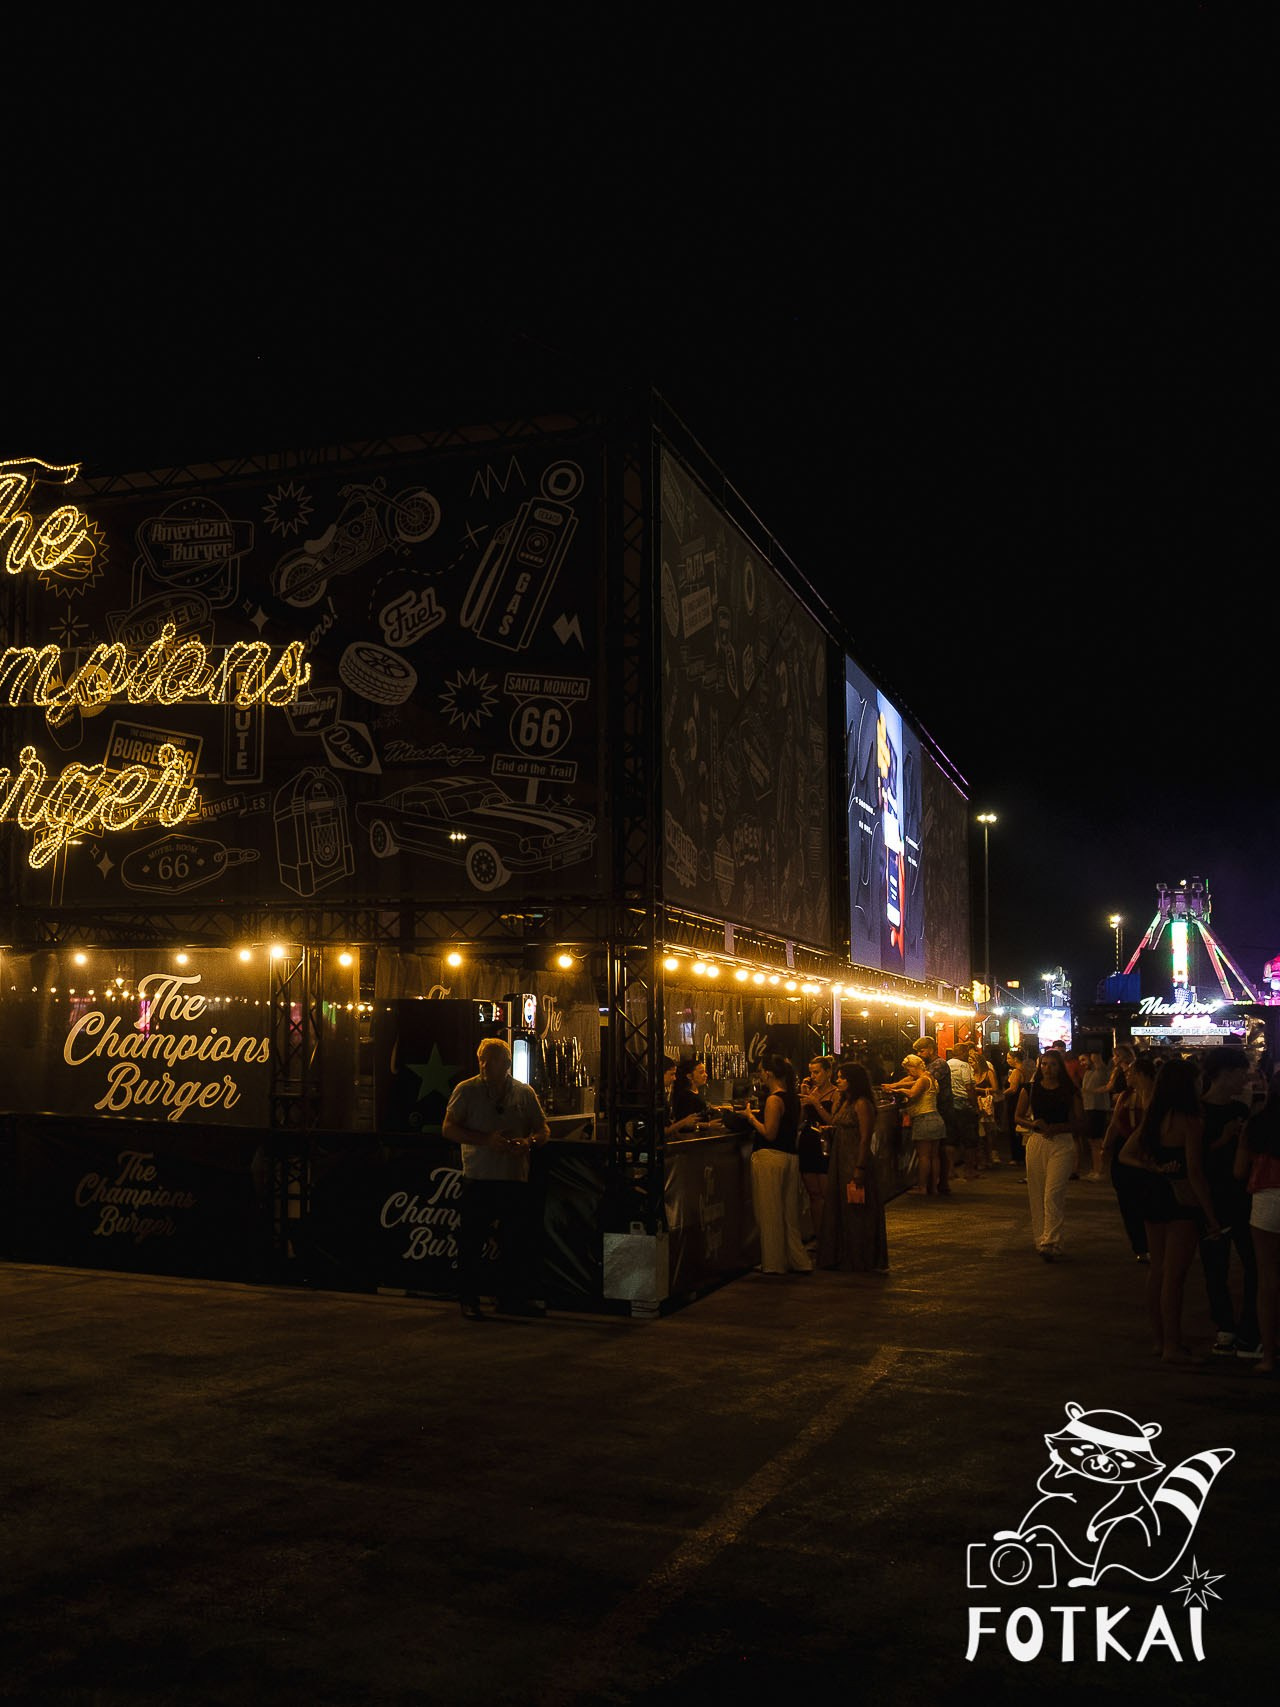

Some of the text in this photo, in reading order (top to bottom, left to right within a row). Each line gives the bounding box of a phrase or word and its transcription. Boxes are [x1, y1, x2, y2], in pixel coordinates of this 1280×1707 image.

[150, 520, 233, 541] American
[171, 543, 233, 561] Burger
[498, 571, 532, 637] GAS
[508, 676, 585, 697] SANTA MONICA
[520, 706, 562, 748] 66
[496, 760, 515, 772] End
[530, 763, 546, 776] the
[550, 765, 573, 778] Trail
[159, 854, 189, 881] 66
[133, 973, 208, 1030] The
[63, 1011, 270, 1068] Champions
[94, 1061, 242, 1122] Burger
[114, 1150, 158, 1186] The
[427, 1166, 464, 1205] Th
[73, 1171, 199, 1211] Champions
[91, 1204, 177, 1247] Burger
